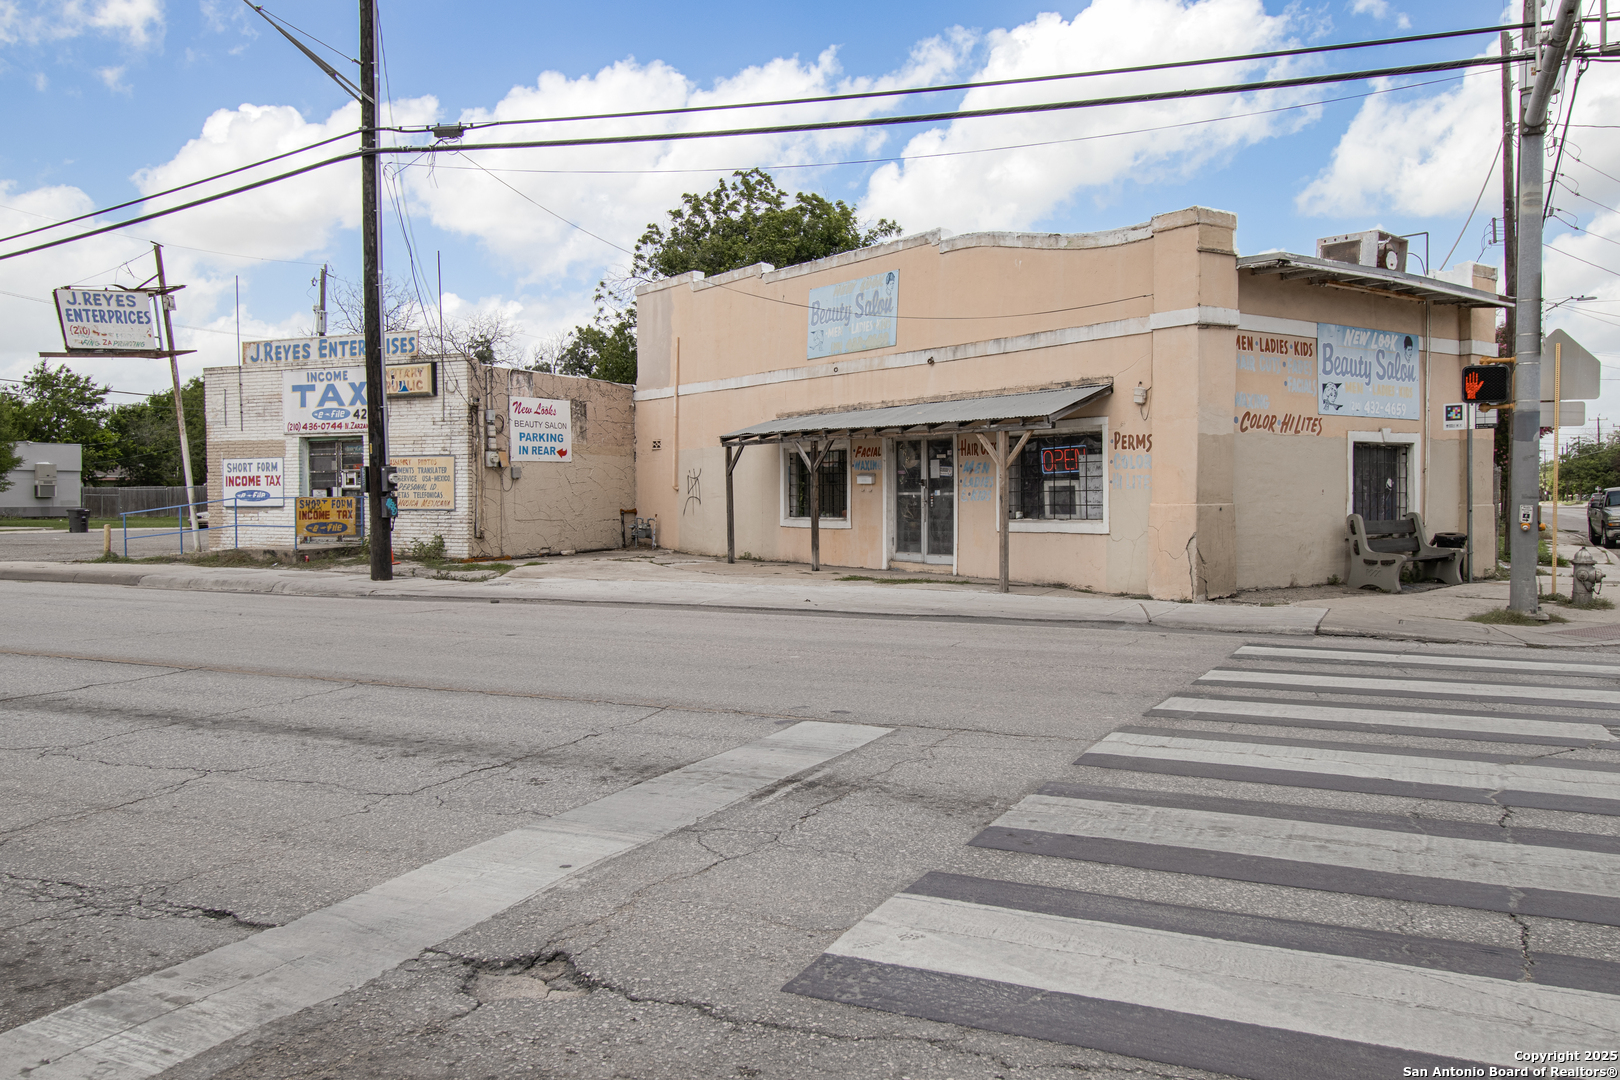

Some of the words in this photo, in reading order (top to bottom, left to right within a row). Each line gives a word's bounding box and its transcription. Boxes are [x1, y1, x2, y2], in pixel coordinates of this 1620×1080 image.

[66, 291, 137, 308] J.REYES
[65, 308, 151, 325] ENTERPRICES
[811, 300, 852, 327] Beauty
[855, 290, 893, 318] Salon
[318, 336, 416, 359] ENTERISES
[1259, 337, 1288, 355] LADIES
[1293, 341, 1313, 357] KIDS
[1343, 328, 1371, 346] NEW
[1371, 330, 1398, 352] LOOK
[1259, 354, 1281, 375] CUTS
[1287, 357, 1313, 377] FADES
[1321, 342, 1372, 386] Beauty
[1375, 349, 1416, 382] Salon
[306, 370, 348, 383] INCOME
[291, 381, 367, 408] TAX
[1287, 376, 1317, 397] FACIALS
[1345, 382, 1363, 394] MEN
[1372, 384, 1395, 397] LADIES
[1399, 386, 1413, 399] KIDS
[512, 401, 533, 415] New
[533, 403, 557, 416] Looks
[1364, 400, 1406, 416] 432-4659
[302, 422, 343, 431] 436-0744
[514, 420, 543, 429] BEAUTY
[544, 421, 567, 430] SALON
[1240, 411, 1277, 433] COLOR
[519, 432, 564, 443] PARKING
[1113, 431, 1153, 453] PERMS
[518, 445, 529, 455] IN
[531, 446, 556, 456] REAR
[855, 445, 882, 458] FACIAL
[960, 438, 979, 457] HAIR
[226, 462, 253, 473] SHORT
[256, 461, 278, 472] FORM
[853, 459, 882, 471] WAXING
[962, 460, 991, 474] MEN
[1113, 452, 1152, 470] COLOR
[225, 475, 261, 487] INCOME
[265, 475, 281, 487] TAX
[962, 476, 994, 488] LADIES
[970, 489, 992, 502] KIDS
[299, 510, 330, 520] INCOME
[337, 510, 353, 520] TAX
